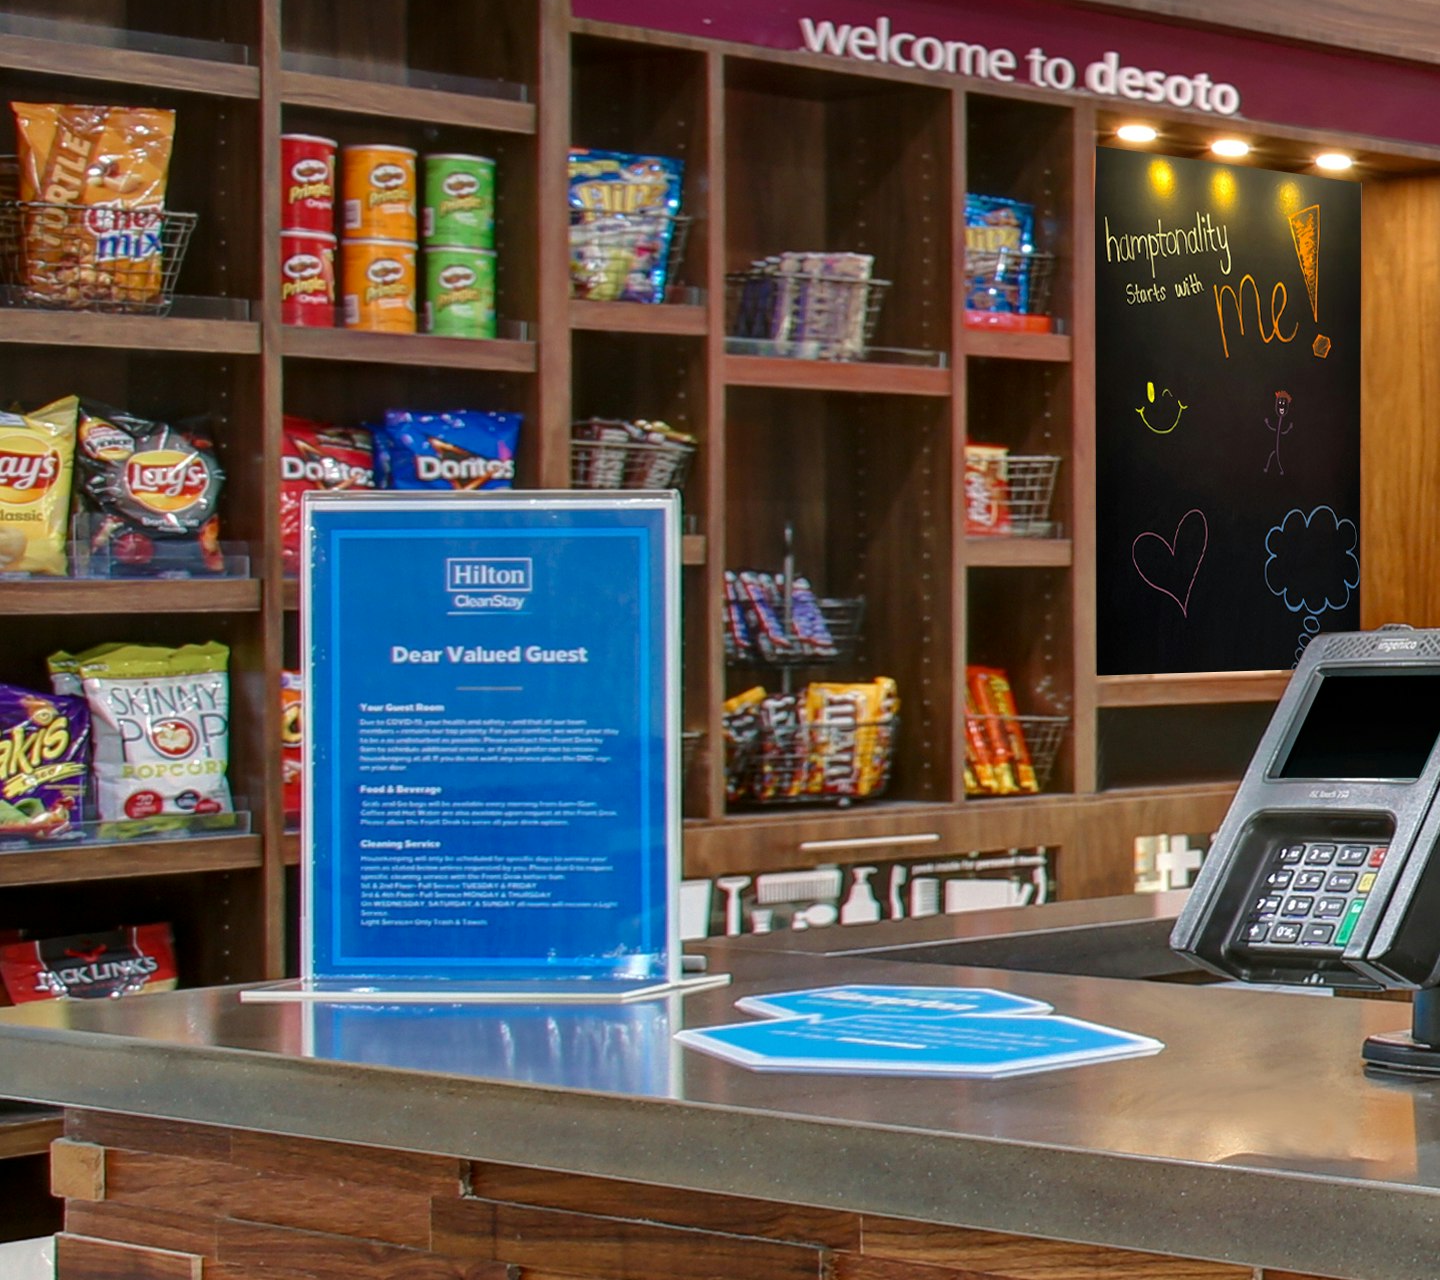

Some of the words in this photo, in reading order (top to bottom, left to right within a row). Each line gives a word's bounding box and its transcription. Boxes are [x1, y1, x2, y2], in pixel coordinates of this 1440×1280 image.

[799, 16, 1017, 82] welcome
[1025, 47, 1076, 90] to
[1085, 52, 1240, 115] desoto
[1104, 211, 1232, 279] hamptonality
[1125, 282, 1167, 305] Starts
[1174, 273, 1205, 298] with
[416, 455, 515, 481] Doritos
[454, 564, 525, 585] Hilton
[454, 594, 526, 610] CleanStay
[392, 646, 442, 663] Dear
[447, 646, 521, 663] Valued
[526, 646, 589, 663] Guest
[110, 682, 220, 716] SKINNY
[360, 703, 384, 712] Your
[385, 703, 414, 712] Guest
[116, 712, 229, 762] POP
